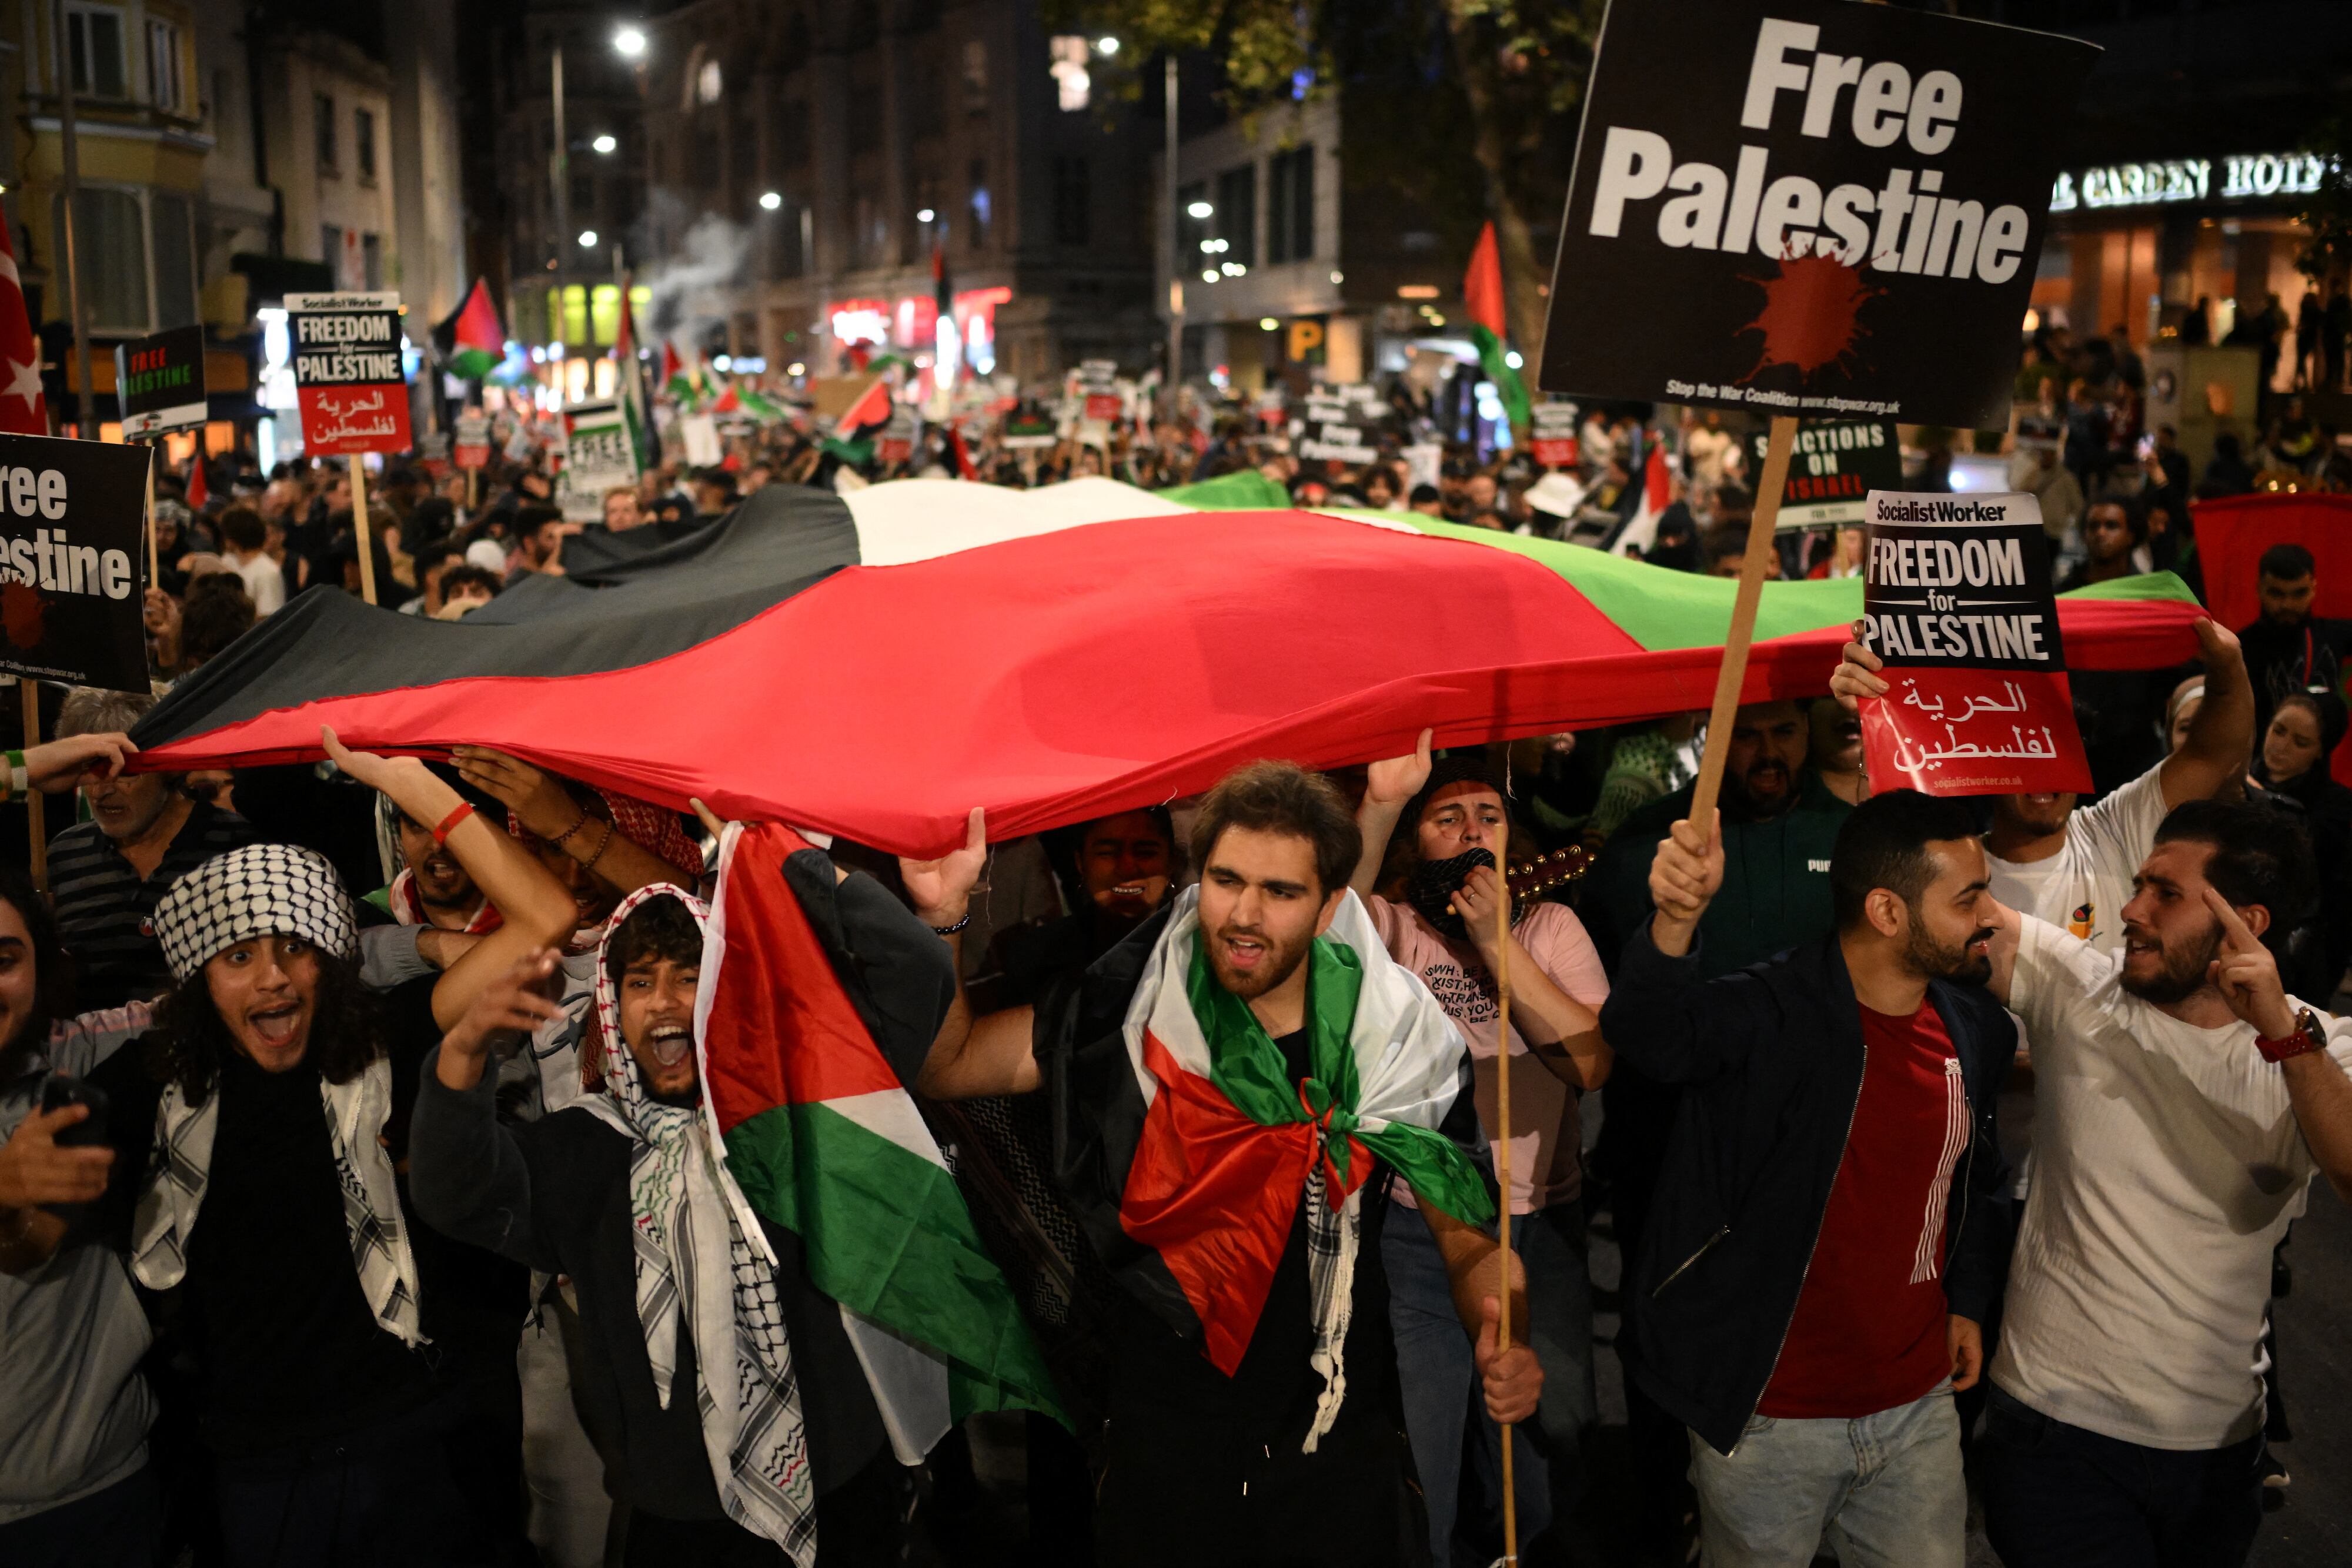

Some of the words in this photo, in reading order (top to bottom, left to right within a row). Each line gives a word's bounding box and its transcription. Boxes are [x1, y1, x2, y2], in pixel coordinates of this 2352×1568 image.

[1740, 18, 1963, 155] Free
[2220, 151, 2337, 196] HOTE
[1589, 126, 2029, 284] Palestine
[297, 315, 391, 343] FREEDOM
[1289, 320, 1323, 362] P
[131, 346, 166, 374] FREE
[339, 342, 355, 355] for
[296, 353, 400, 382] PALESTINE
[317, 390, 384, 419] الحرية
[1665, 379, 1696, 397] Stop
[1697, 383, 1718, 399] the
[1719, 385, 1744, 400] War
[1745, 387, 1799, 407] Coalition
[1800, 395, 1900, 415] www.stopwar.org.uk
[313, 414, 396, 444] لفلسطين
[1755, 423, 1885, 459] SCTIONS
[1808, 452, 1839, 476] ON
[1788, 473, 1864, 500] ISRAEL
[1869, 537, 2026, 587] FREEDOM
[1927, 589, 1956, 611] for
[1863, 614, 2049, 660] PALESTINE
[1902, 678, 2027, 721] الحرية
[1894, 723, 2057, 772] لفلسطين
[1934, 775, 2023, 788] socialistworker.co.uk
[1467, 1000, 1493, 1016] YOU
[1470, 1015, 1488, 1024] BE
